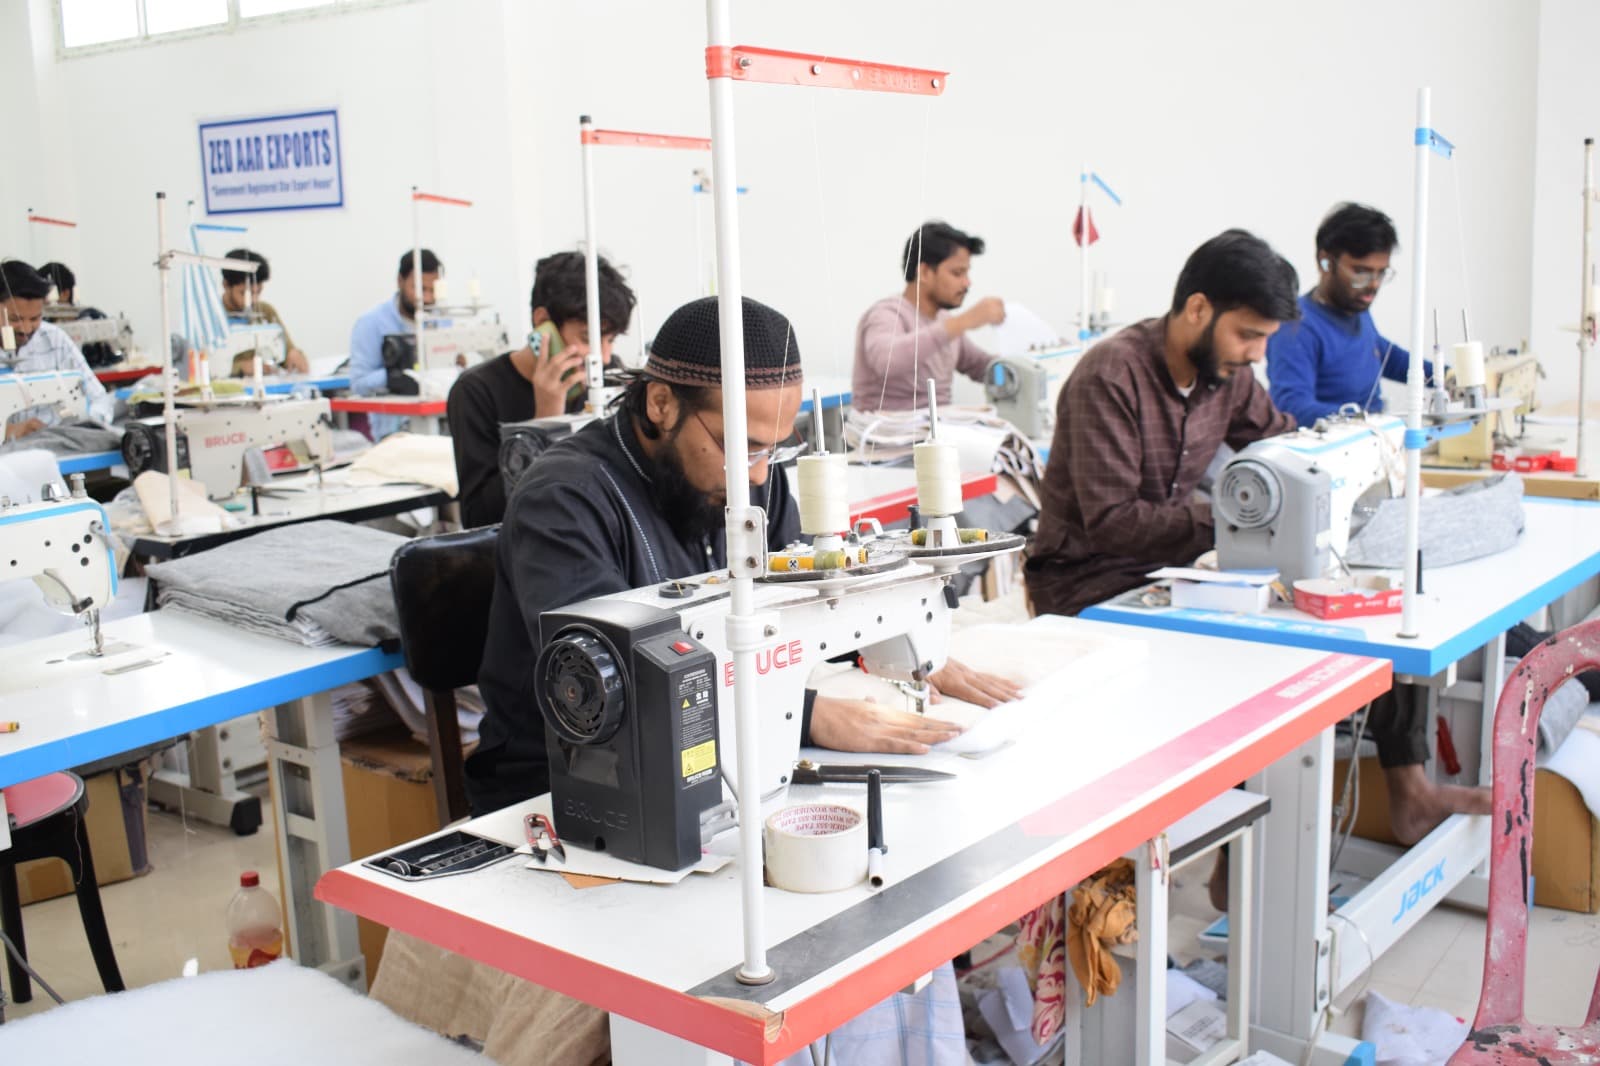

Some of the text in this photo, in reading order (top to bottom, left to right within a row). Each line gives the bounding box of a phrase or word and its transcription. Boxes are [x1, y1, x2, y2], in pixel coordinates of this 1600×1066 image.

[209, 129, 333, 175] ZED AAR EXPORTS
[724, 639, 804, 687] BUCE
